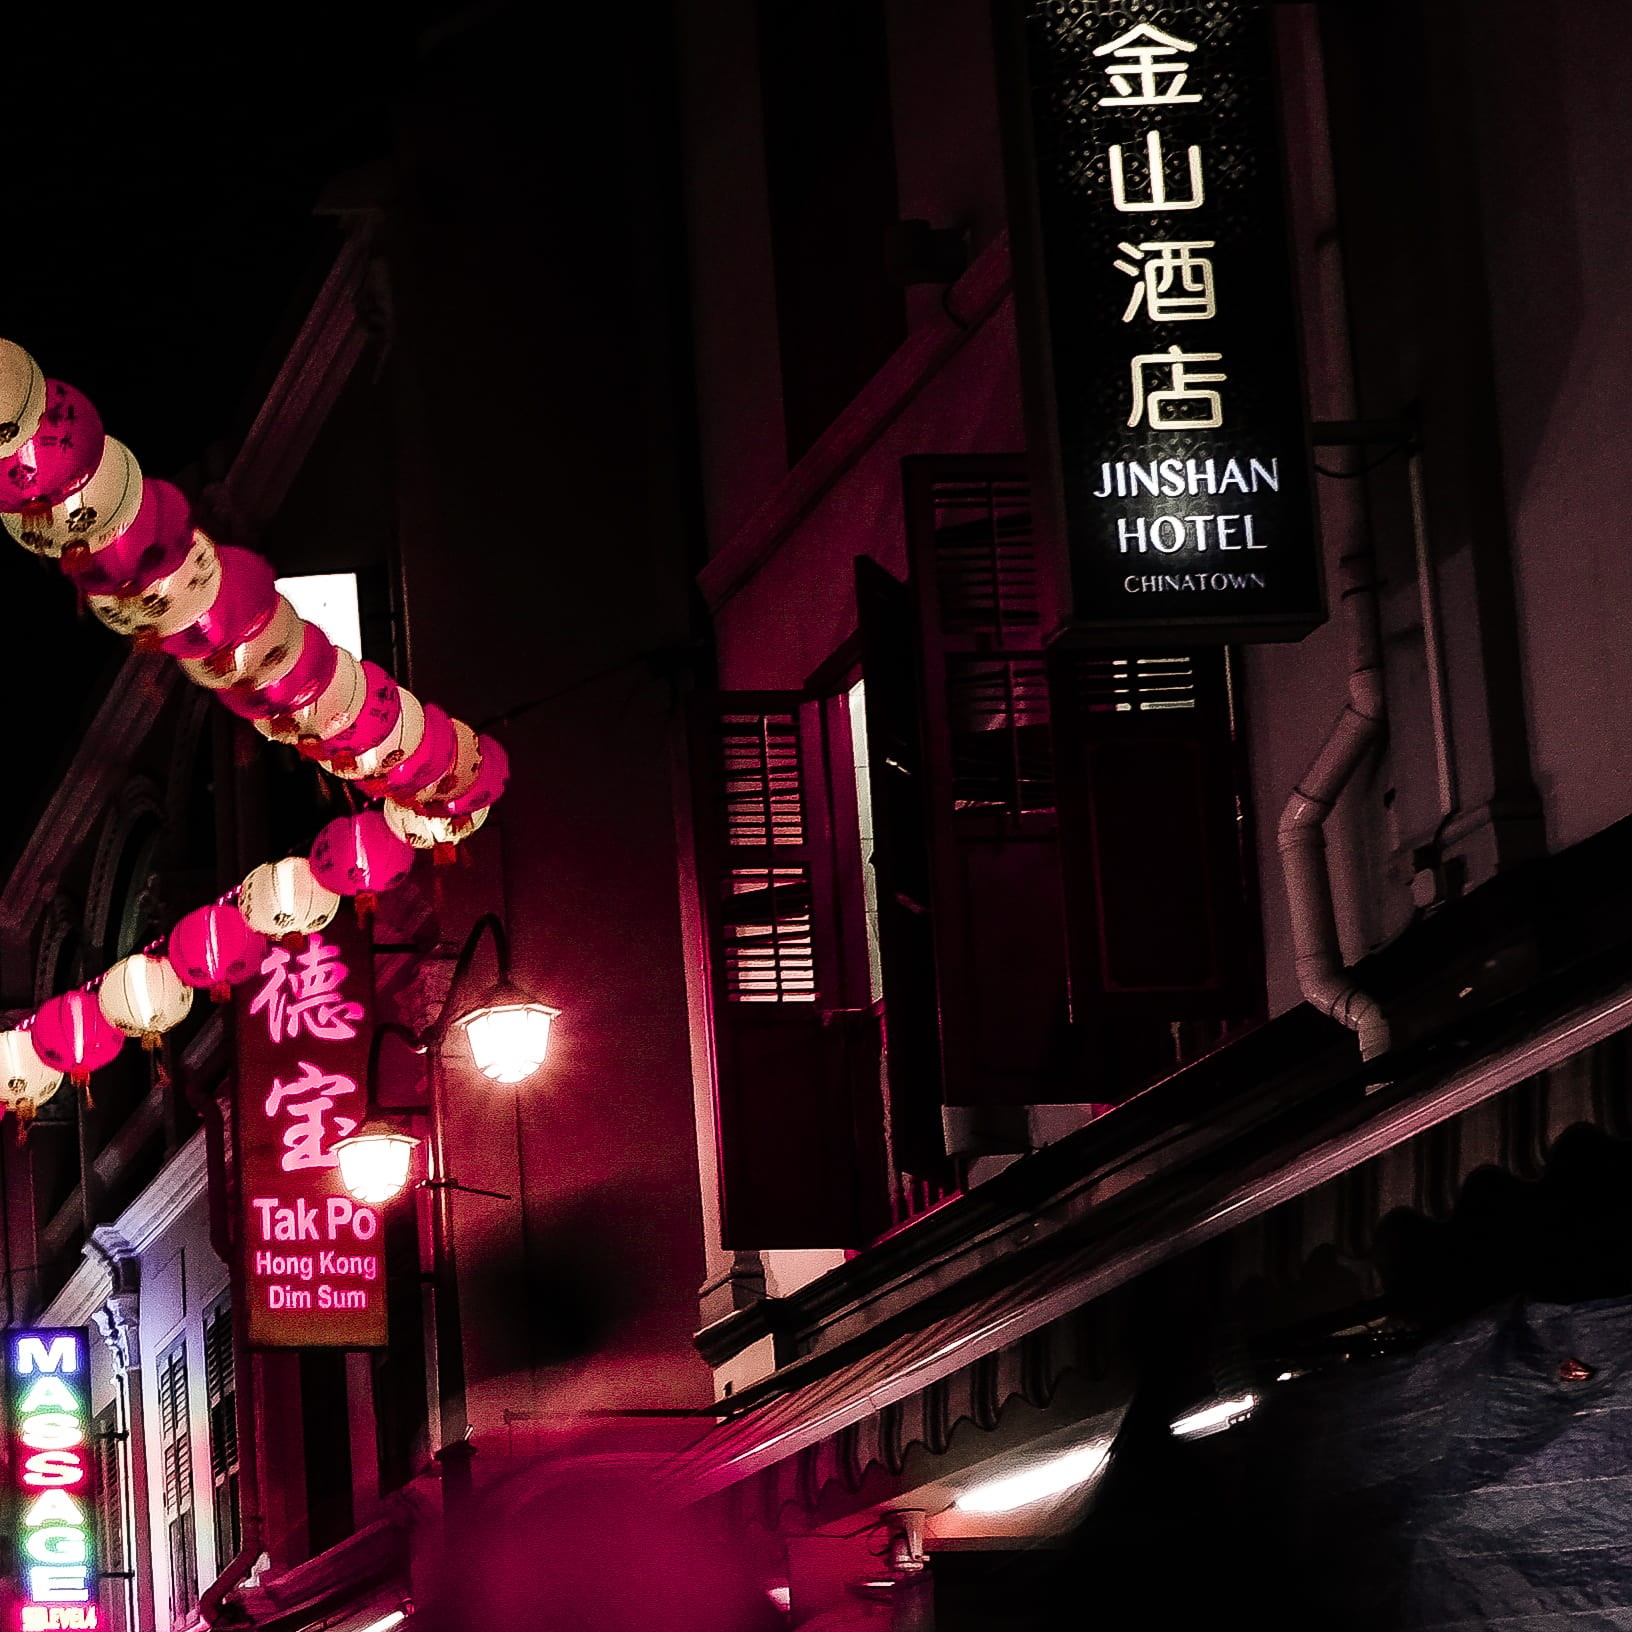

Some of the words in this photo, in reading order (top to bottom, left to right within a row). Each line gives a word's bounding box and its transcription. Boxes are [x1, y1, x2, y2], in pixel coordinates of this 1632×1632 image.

[1091, 22, 1227, 431] 金山酒店
[1092, 457, 1280, 499] JINSHAN
[1117, 513, 1268, 554] HOTEL
[1124, 573, 1266, 593] CHINATOWN
[249, 933, 365, 1172] 德宝
[252, 1197, 320, 1241] Tak
[326, 1197, 377, 1241] Po
[255, 1250, 313, 1281] Hong
[319, 1250, 377, 1280] Kong
[268, 1285, 311, 1309] Dim
[317, 1284, 366, 1309] Sum
[16, 1335, 90, 1603] MASSAGE
